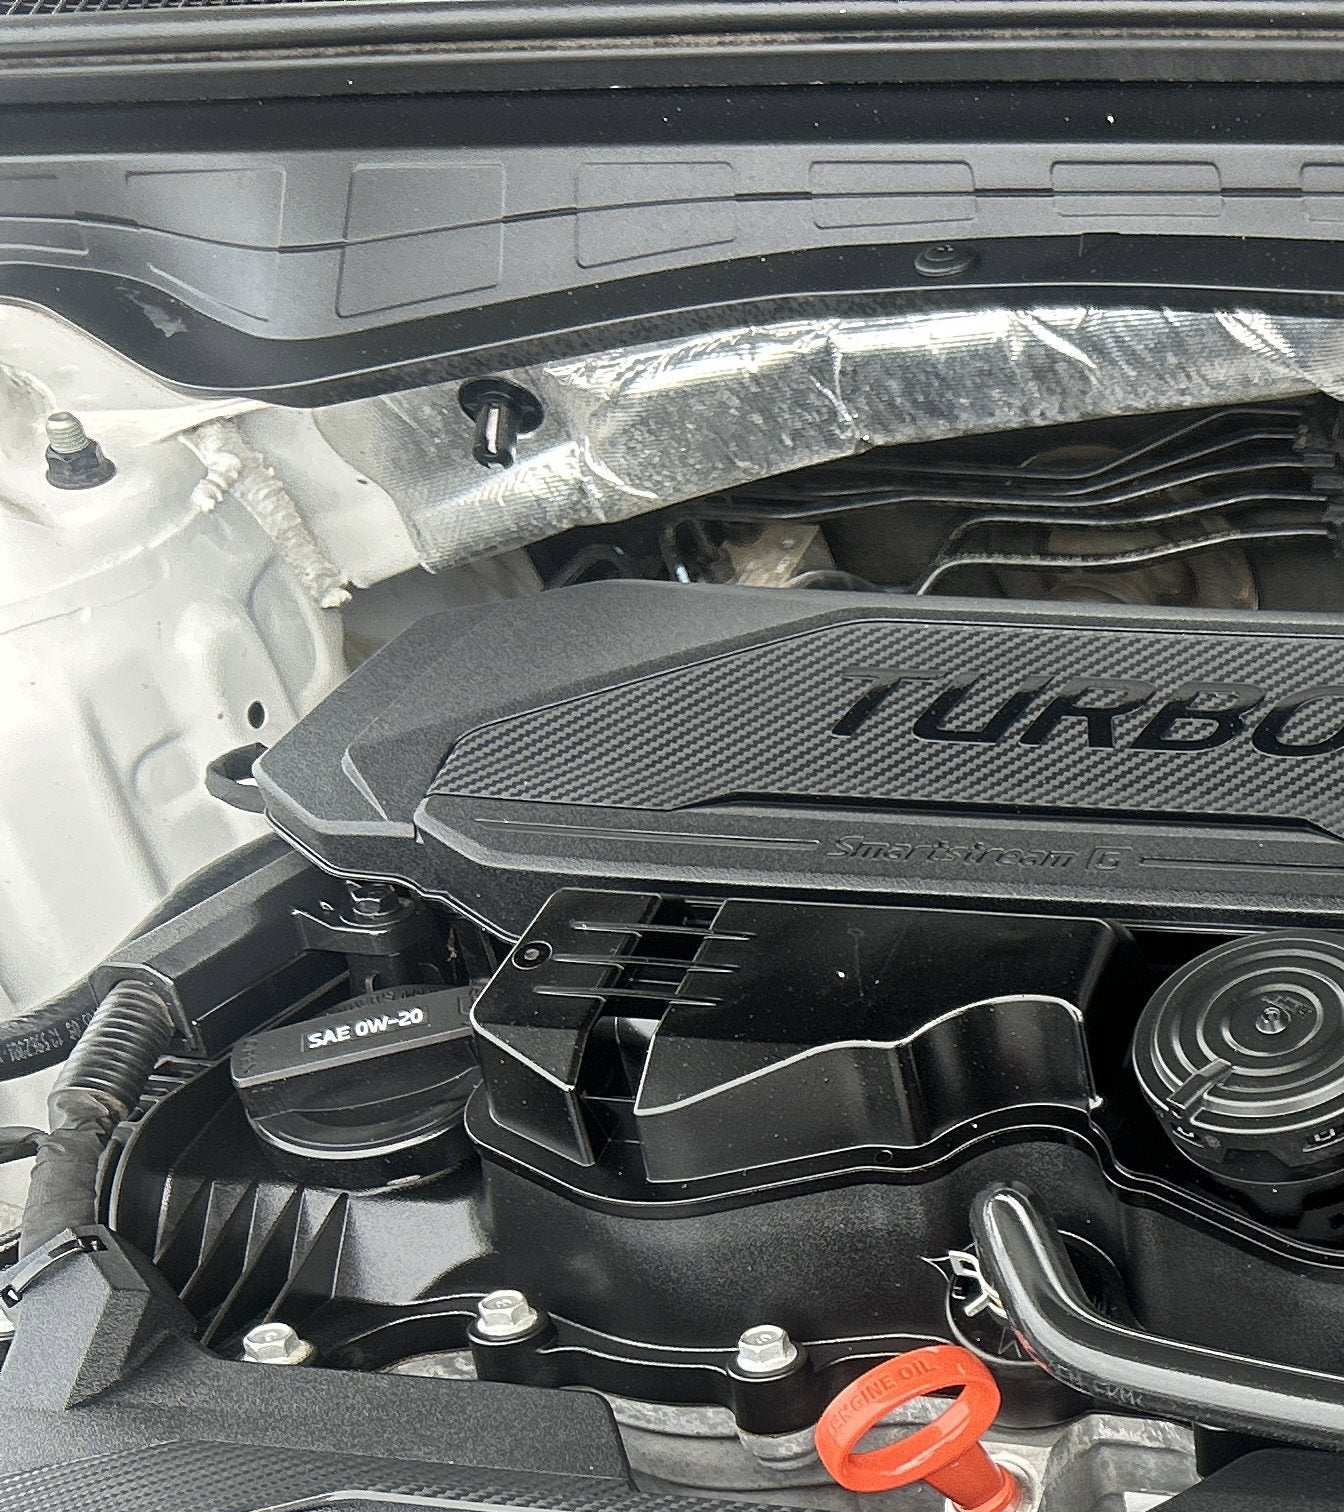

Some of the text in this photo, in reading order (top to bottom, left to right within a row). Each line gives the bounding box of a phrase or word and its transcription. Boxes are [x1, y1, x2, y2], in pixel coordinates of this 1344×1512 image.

[825, 834, 1077, 870] Smartstream
[307, 1024, 350, 1050] SAE
[824, 1351, 938, 1435] ENGINE OIL
